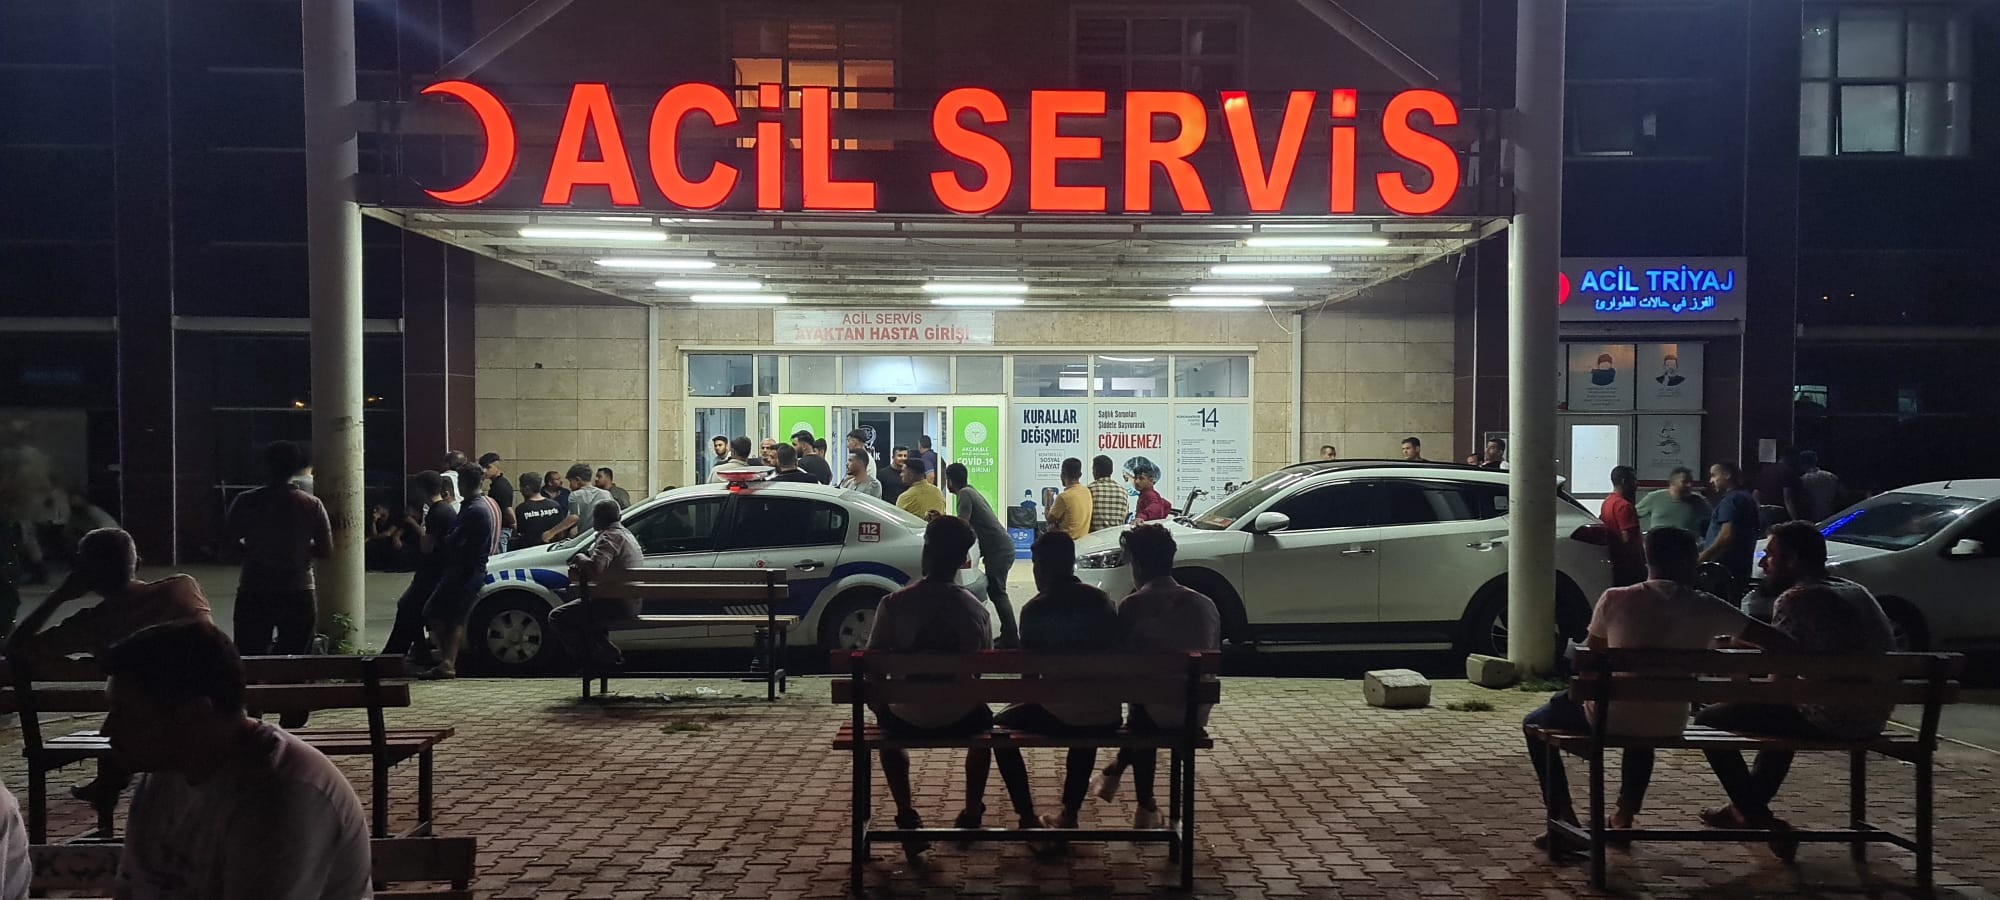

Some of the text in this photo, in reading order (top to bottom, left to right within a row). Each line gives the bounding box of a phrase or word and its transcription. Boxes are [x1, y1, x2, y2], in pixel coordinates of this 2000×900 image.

[1580, 264, 1735, 292] ACİL TRİYAJ
[1595, 295, 1715, 313] الفرز في حالات الطوارئ
[842, 311, 922, 325] ACİL SERVİS
[795, 324, 970, 344] AYAKTAN HASTA GİRİŞİ
[1023, 409, 1077, 424] KURALLAR
[1197, 407, 1219, 428] 14
[1098, 432, 1162, 451] ÇÖZÜLEMEZ!
[861, 523, 878, 535] 112
